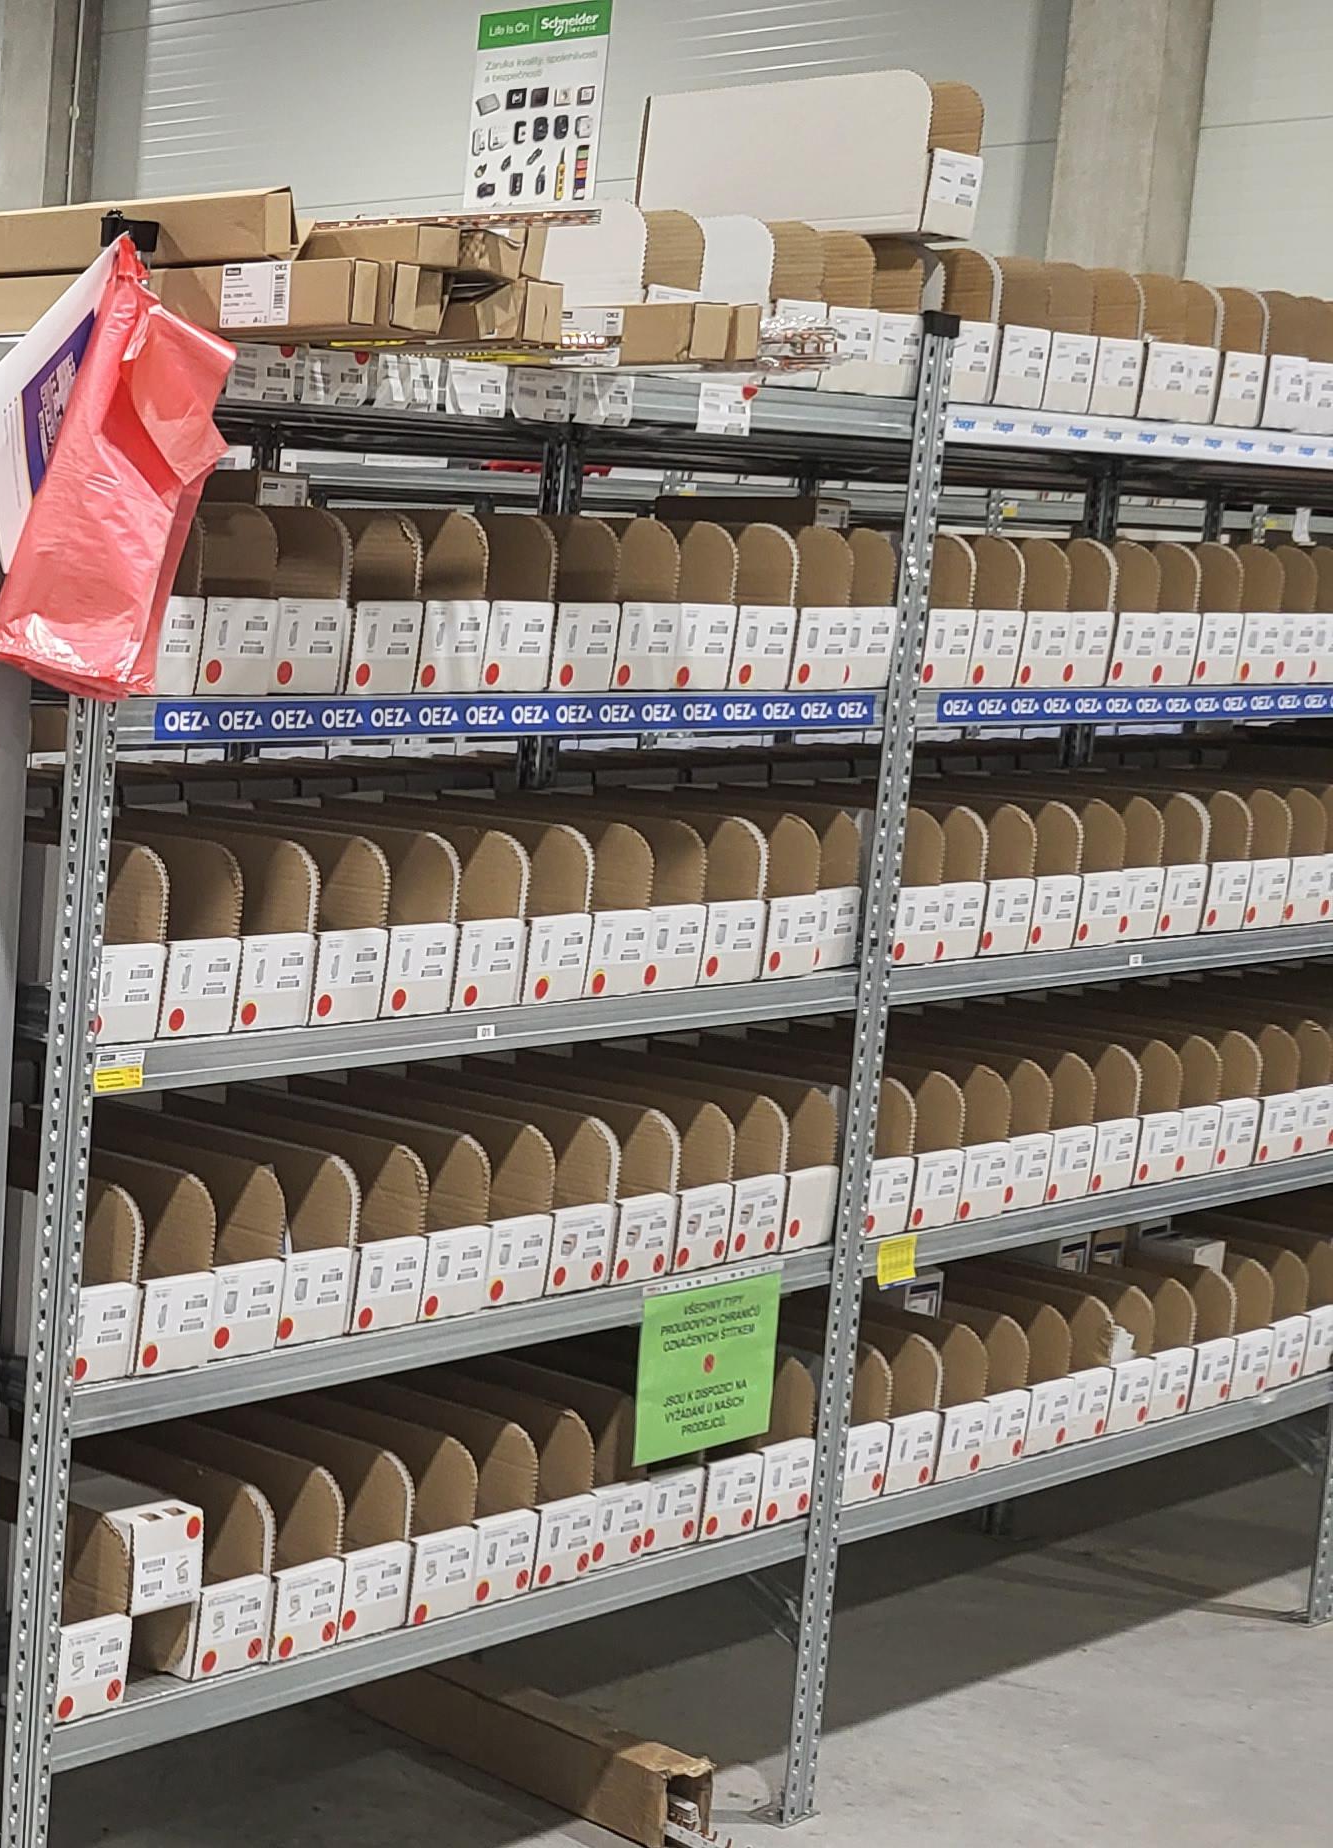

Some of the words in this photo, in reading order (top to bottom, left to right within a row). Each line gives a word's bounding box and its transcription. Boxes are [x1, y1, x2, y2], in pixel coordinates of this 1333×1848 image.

[515, 22, 529, 33] On
[540, 13, 599, 36] Schneider
[943, 699, 968, 716] OEZ
[978, 699, 1003, 715] OEZ
[1011, 698, 1035, 715] OEZ
[1043, 698, 1067, 714] OEZ
[1075, 697, 1098, 714] OEZ
[1106, 697, 1129, 713] OEZ
[1136, 697, 1158, 713] OEZ
[1165, 696, 1187, 712] OEZ
[1194, 696, 1215, 712] OEZ
[1222, 695, 1244, 711] OEZ
[1250, 695, 1270, 710] OEZ
[1277, 694, 1296, 710] OEZ
[1303, 694, 1322, 709] OEZ
[164, 711, 202, 732] OEZ
[218, 710, 255, 731] OEZ
[271, 709, 307, 730] OEZ
[321, 708, 356, 728] OEZ
[371, 707, 405, 727] OEZ
[418, 706, 452, 727] OEZ
[465, 705, 498, 726] OEZ
[511, 705, 543, 725] OEZ
[555, 704, 587, 724] OEZ
[599, 704, 629, 723] OEZ
[641, 703, 671, 722] OEZ
[682, 703, 712, 722] OEZ
[723, 702, 752, 721] OEZ
[762, 702, 790, 720] OEZ
[800, 701, 828, 719] OEZ
[837, 701, 863, 719] OEZ
[684, 1297, 722, 1316] VŠECHNY
[660, 1315, 718, 1337] PROUDOVÝCH
[694, 1382, 734, 1401] DISPOZICI
[735, 1378, 747, 1390] NA
[706, 1403, 712, 1414] U
[714, 1396, 745, 1412] NAŠICH
